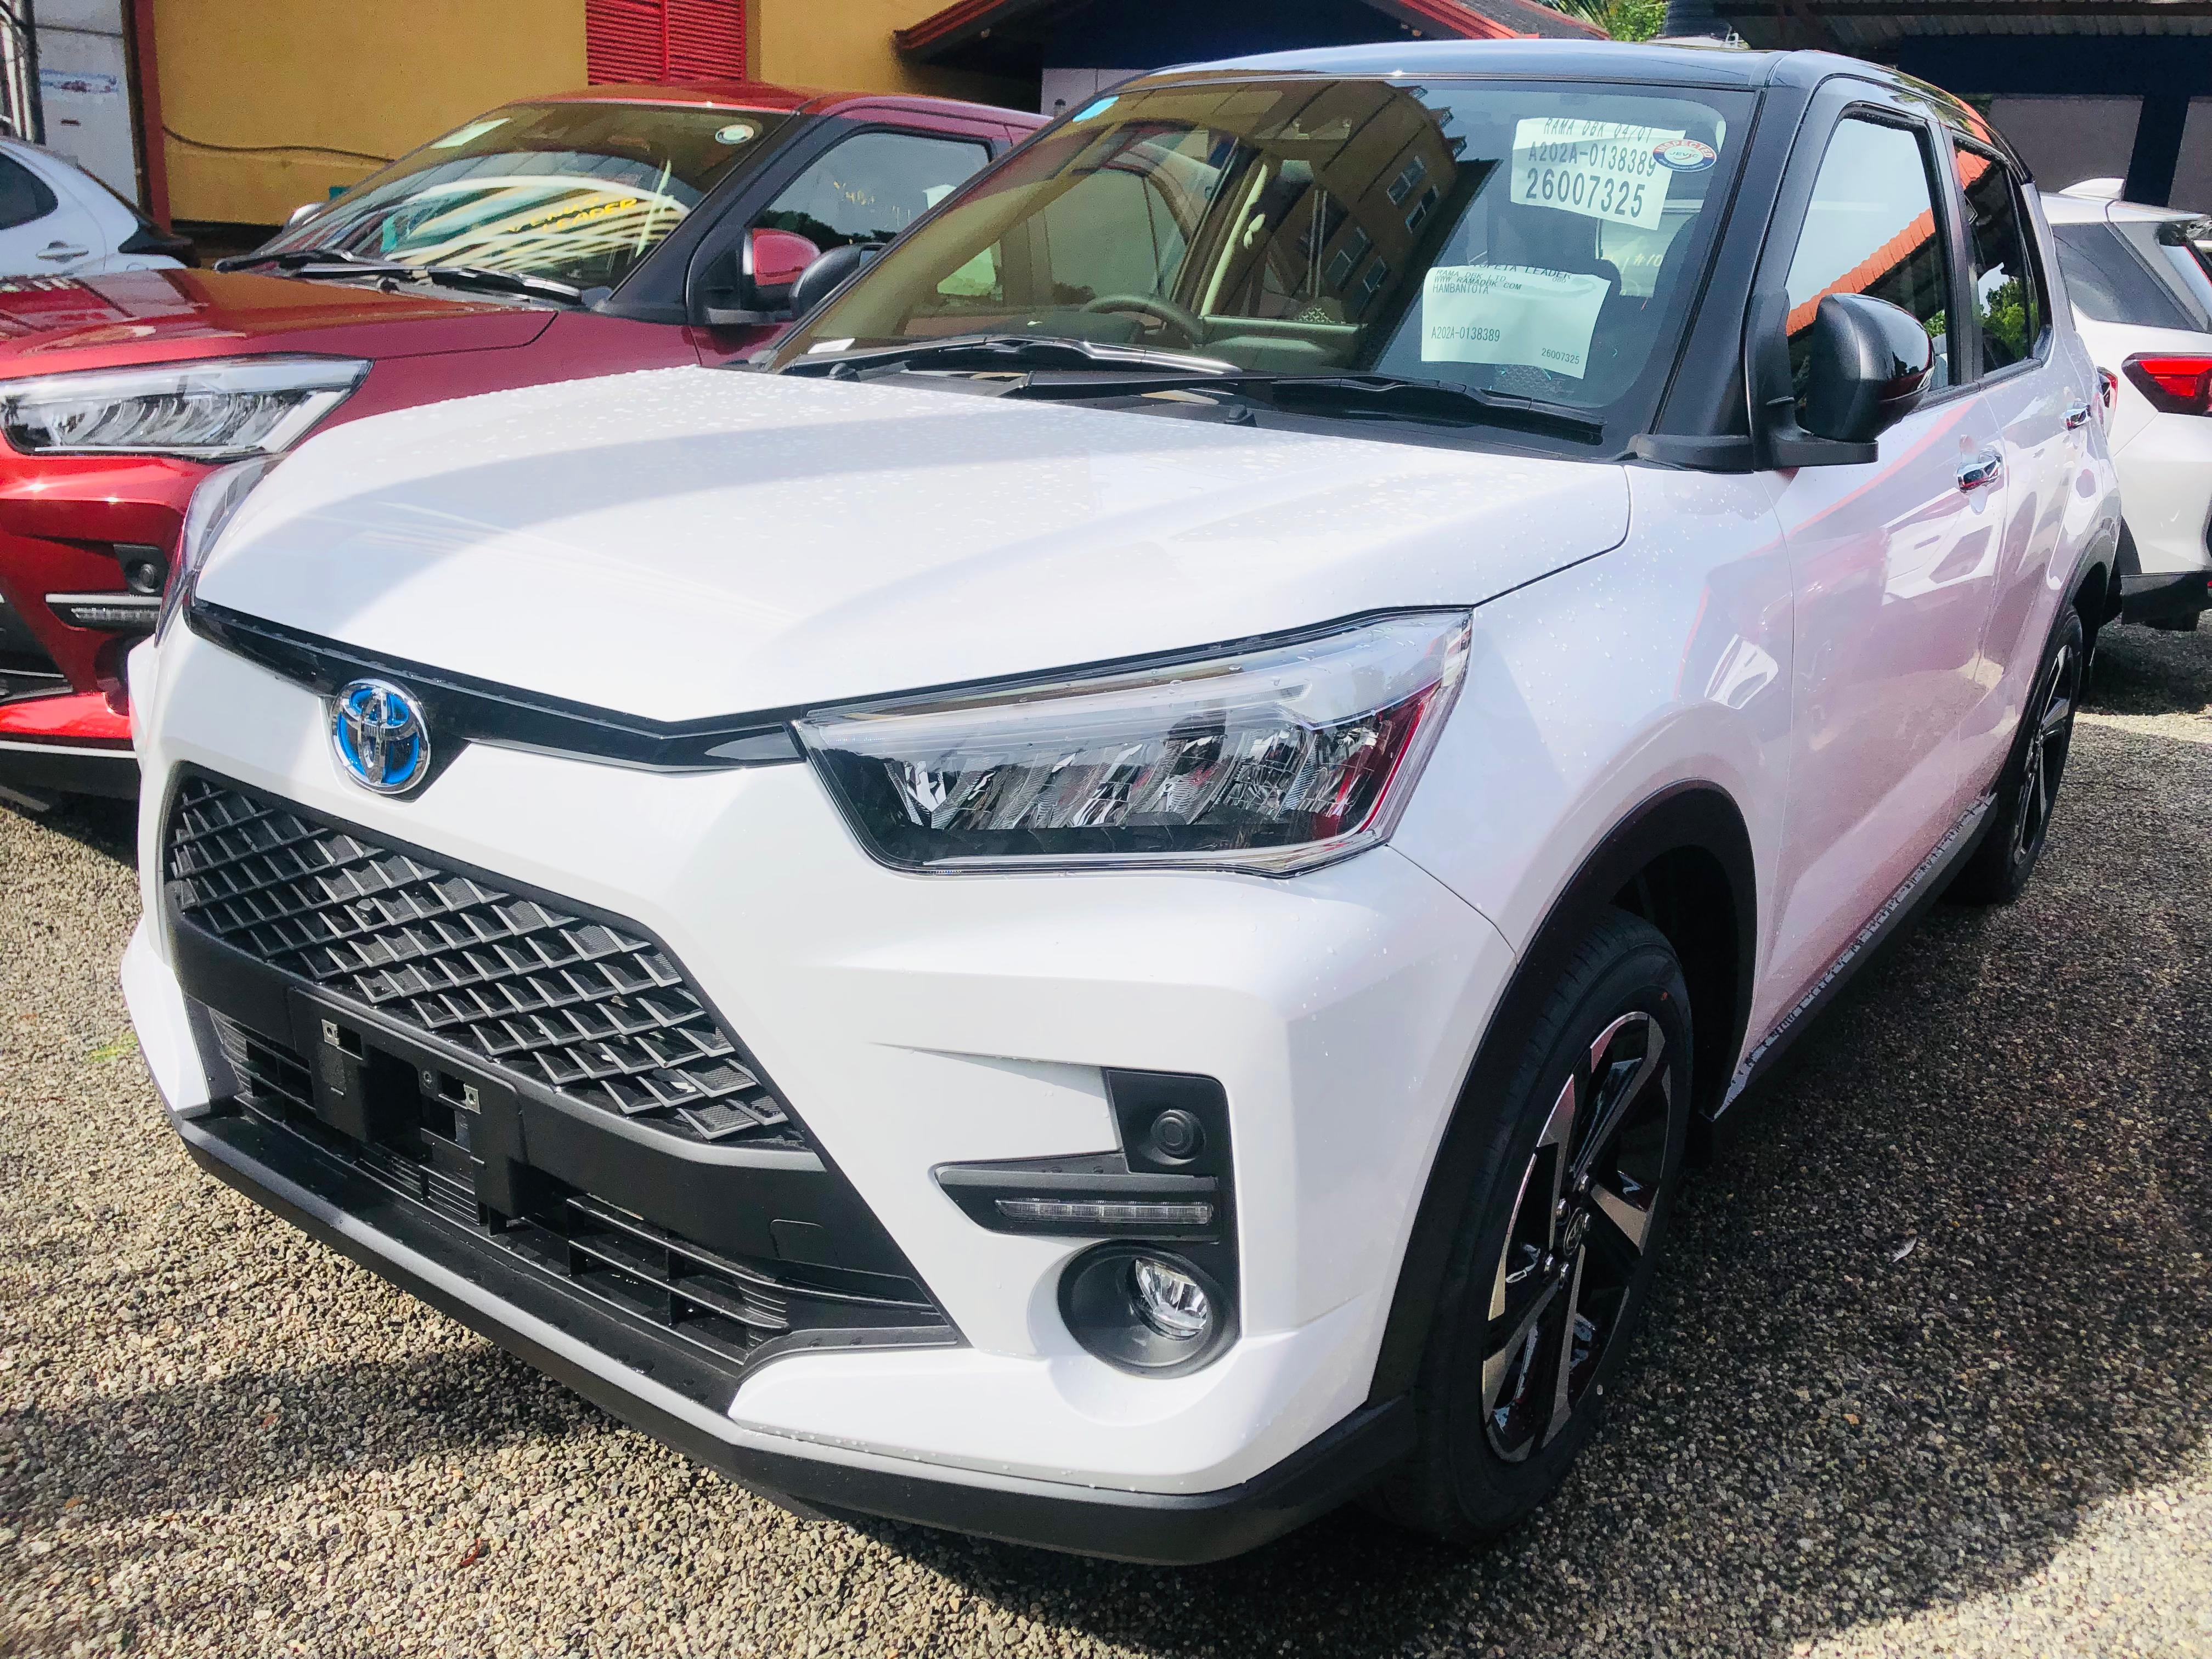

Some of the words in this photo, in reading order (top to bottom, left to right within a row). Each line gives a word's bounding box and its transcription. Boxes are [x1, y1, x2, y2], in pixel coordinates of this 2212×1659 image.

[1543, 117, 1575, 135] RAMA
[1582, 120, 1607, 137] DBK
[1614, 123, 1654, 143] 04/01
[1654, 140, 1713, 158] INSPECTED
[1528, 141, 1656, 177] A202A-0138389
[1526, 167, 1645, 218] 26007325
[1432, 283, 1489, 295] HAMBANTOTA
[1431, 326, 1500, 342] A202A-0138389
[1542, 348, 1580, 365] 26007325
